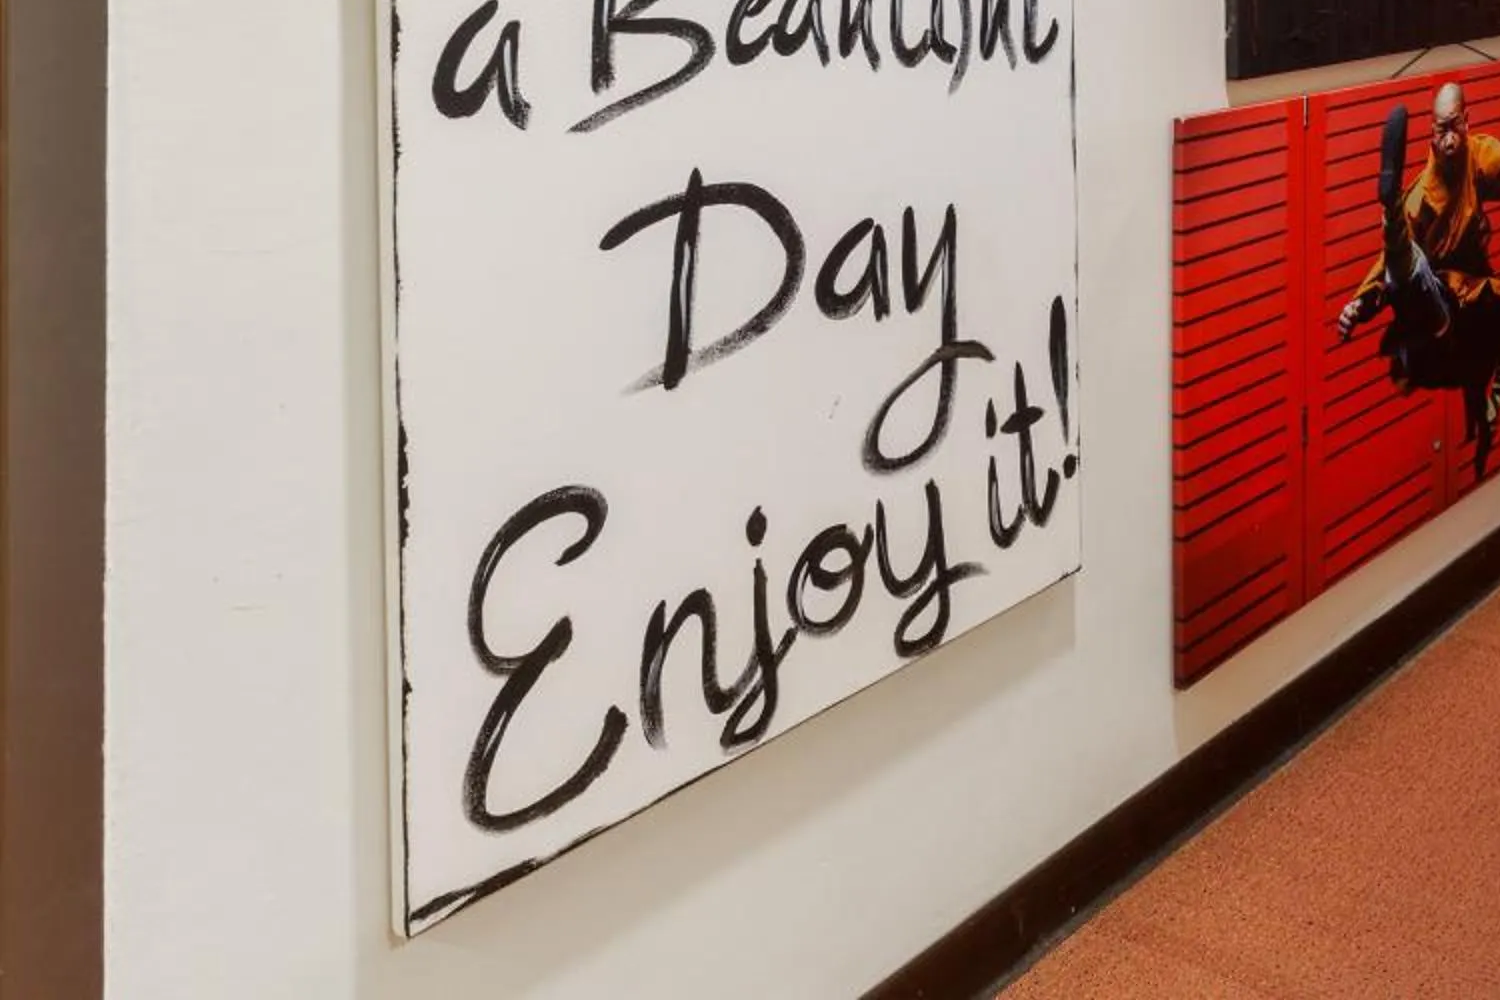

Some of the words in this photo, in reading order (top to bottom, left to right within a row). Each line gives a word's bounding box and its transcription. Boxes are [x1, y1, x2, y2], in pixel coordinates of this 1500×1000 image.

[600, 167, 997, 475] Day
[462, 479, 989, 833] Enjoy
[987, 295, 1078, 549] it!
